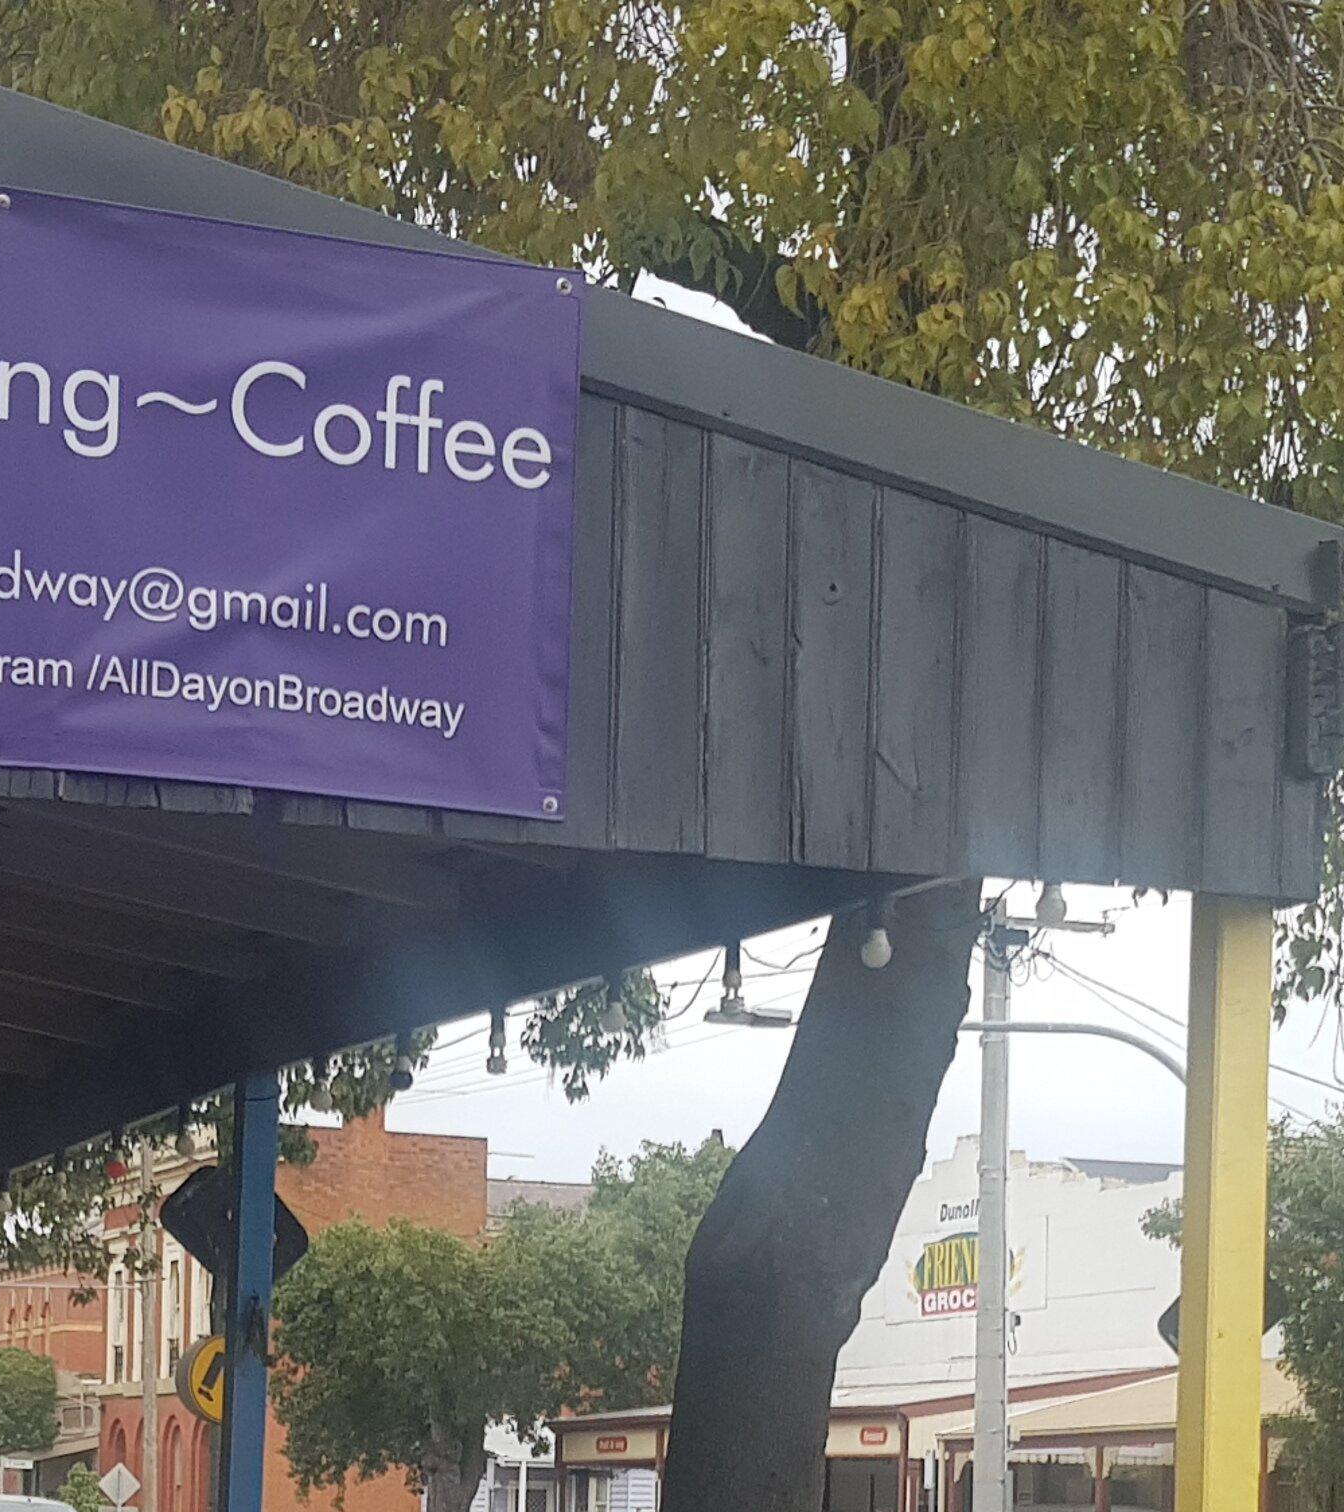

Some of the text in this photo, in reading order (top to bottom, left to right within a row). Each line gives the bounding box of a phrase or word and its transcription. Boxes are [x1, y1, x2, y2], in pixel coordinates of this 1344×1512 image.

[86, 653, 466, 739] /AllDayonBroadway
[939, 1199, 980, 1221] Dunoll
[923, 1237, 980, 1290] FRIEN
[923, 1287, 977, 1313] GROC
